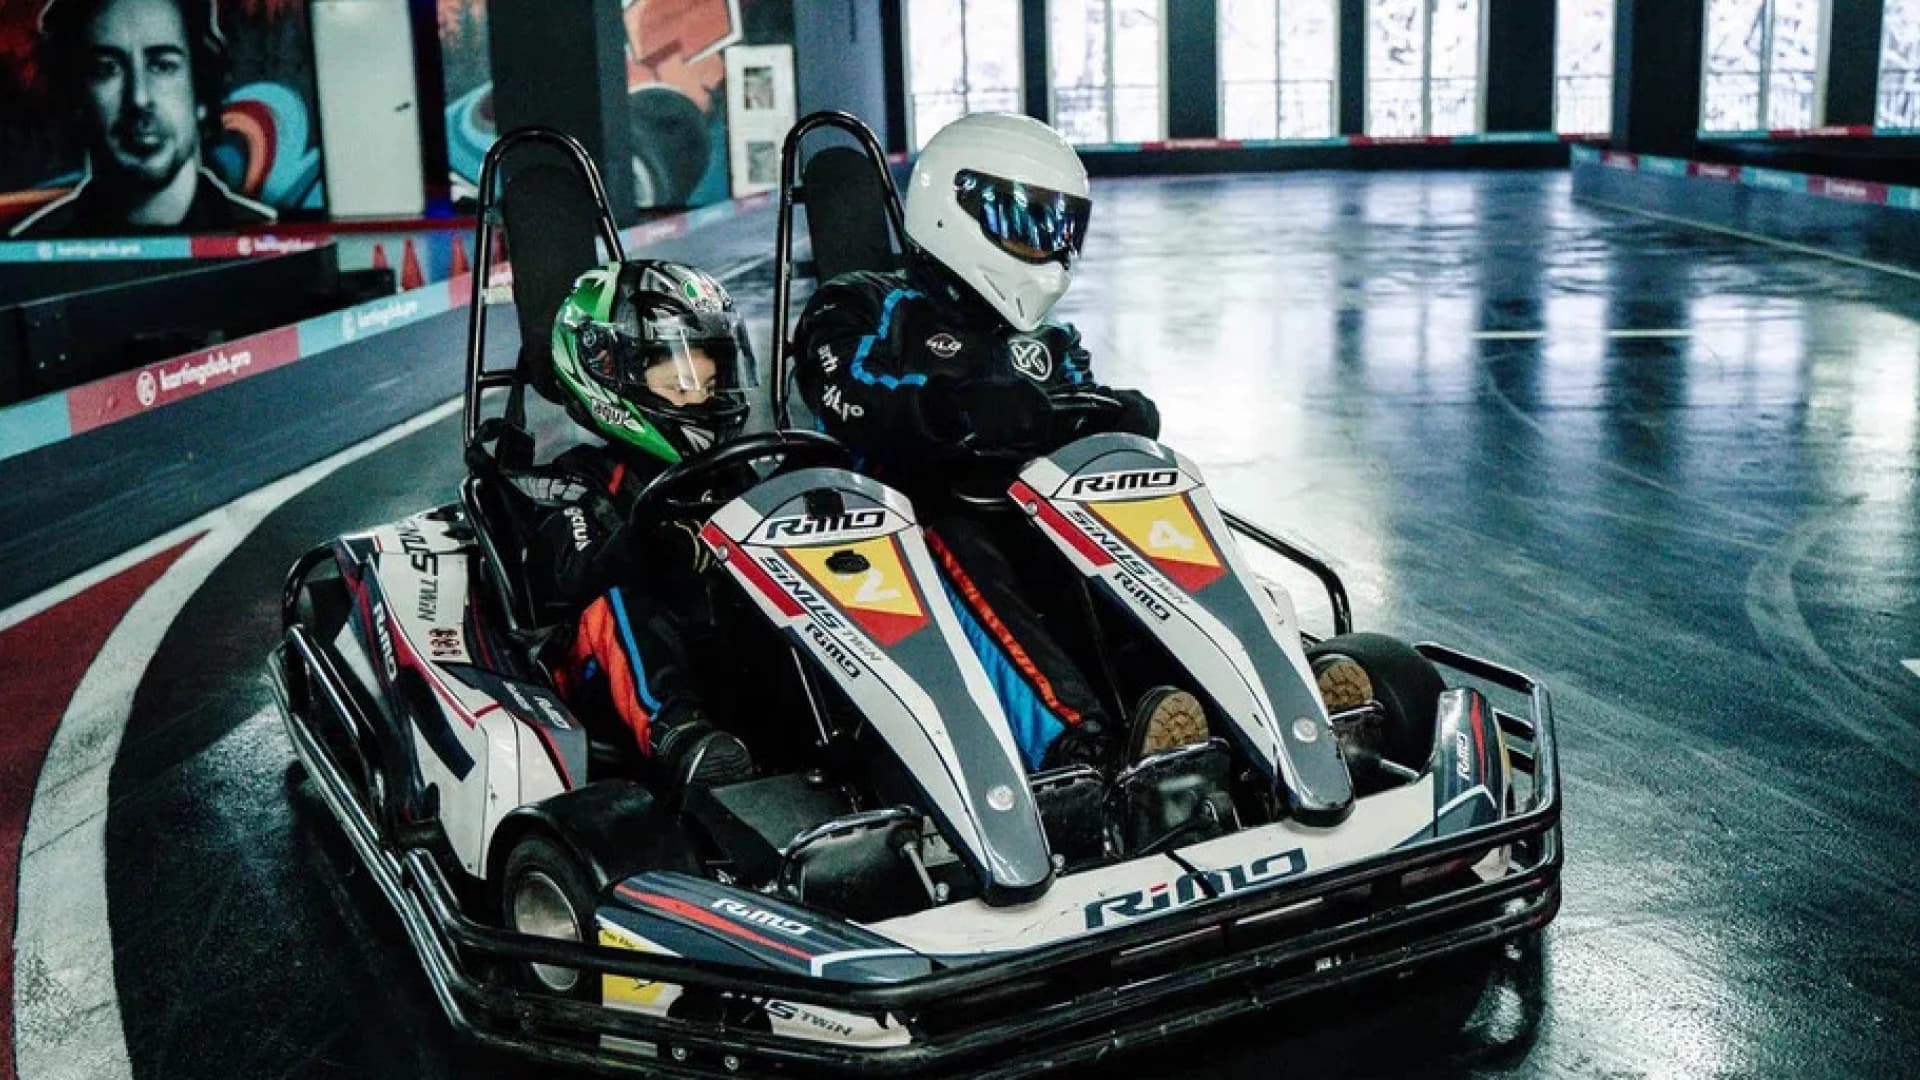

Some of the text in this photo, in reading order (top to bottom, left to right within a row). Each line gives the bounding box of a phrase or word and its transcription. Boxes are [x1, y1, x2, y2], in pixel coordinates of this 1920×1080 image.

[159, 350, 251, 392] kartingclub.pro
[1149, 520, 1195, 550] 4
[855, 567, 901, 603] 2
